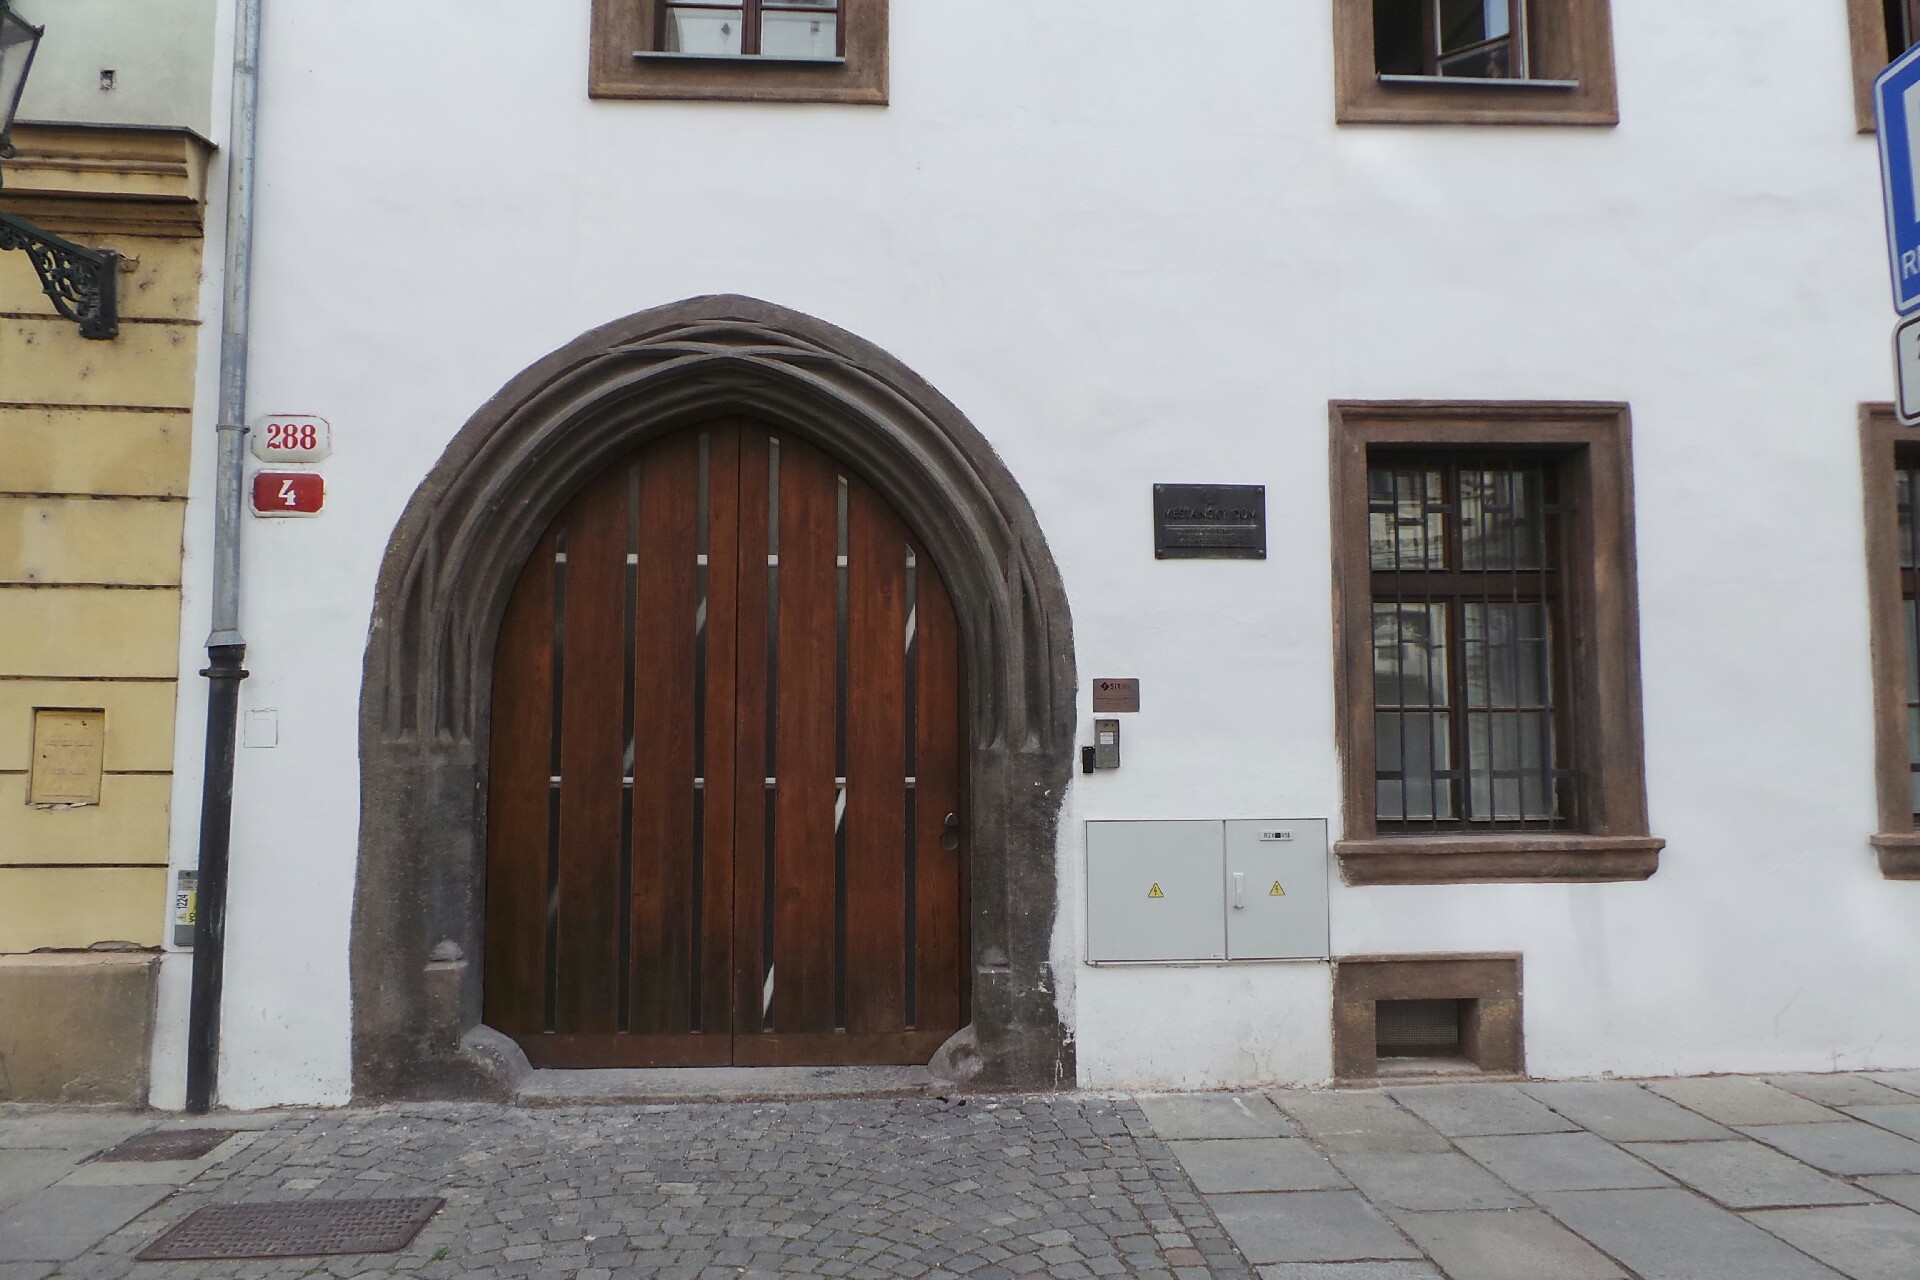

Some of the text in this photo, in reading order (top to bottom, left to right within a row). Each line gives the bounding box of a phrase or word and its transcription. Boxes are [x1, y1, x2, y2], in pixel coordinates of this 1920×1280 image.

[1902, 244, 1920, 280] R
[266, 423, 317, 450] 288
[278, 479, 296, 506] 4
[176, 894, 188, 909] 1224
